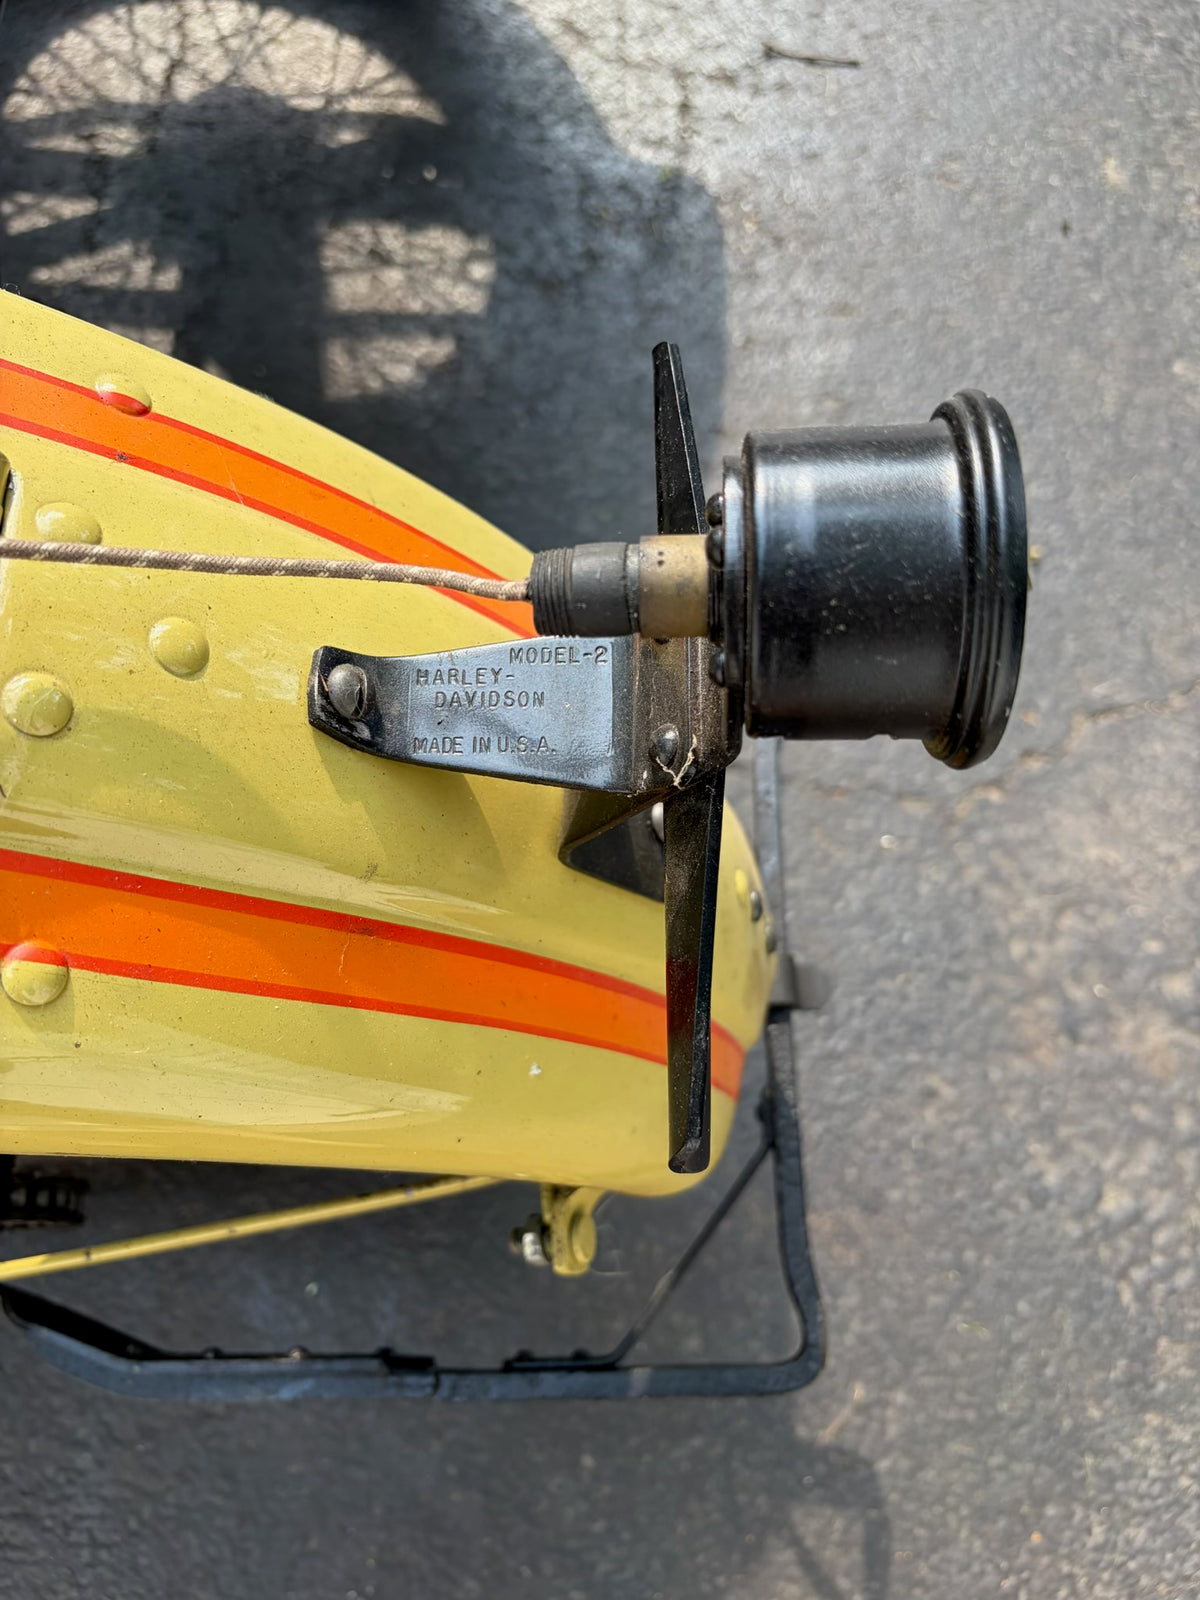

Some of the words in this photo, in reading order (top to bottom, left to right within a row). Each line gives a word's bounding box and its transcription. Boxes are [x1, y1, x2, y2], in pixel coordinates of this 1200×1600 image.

[509, 645, 608, 664] MODEL-2
[416, 667, 515, 687] HARLEY-
[434, 690, 545, 710] DAVIDSON
[413, 736, 464, 755] MADE
[472, 736, 491, 754] IN
[497, 736, 556, 755] U.S.A.
